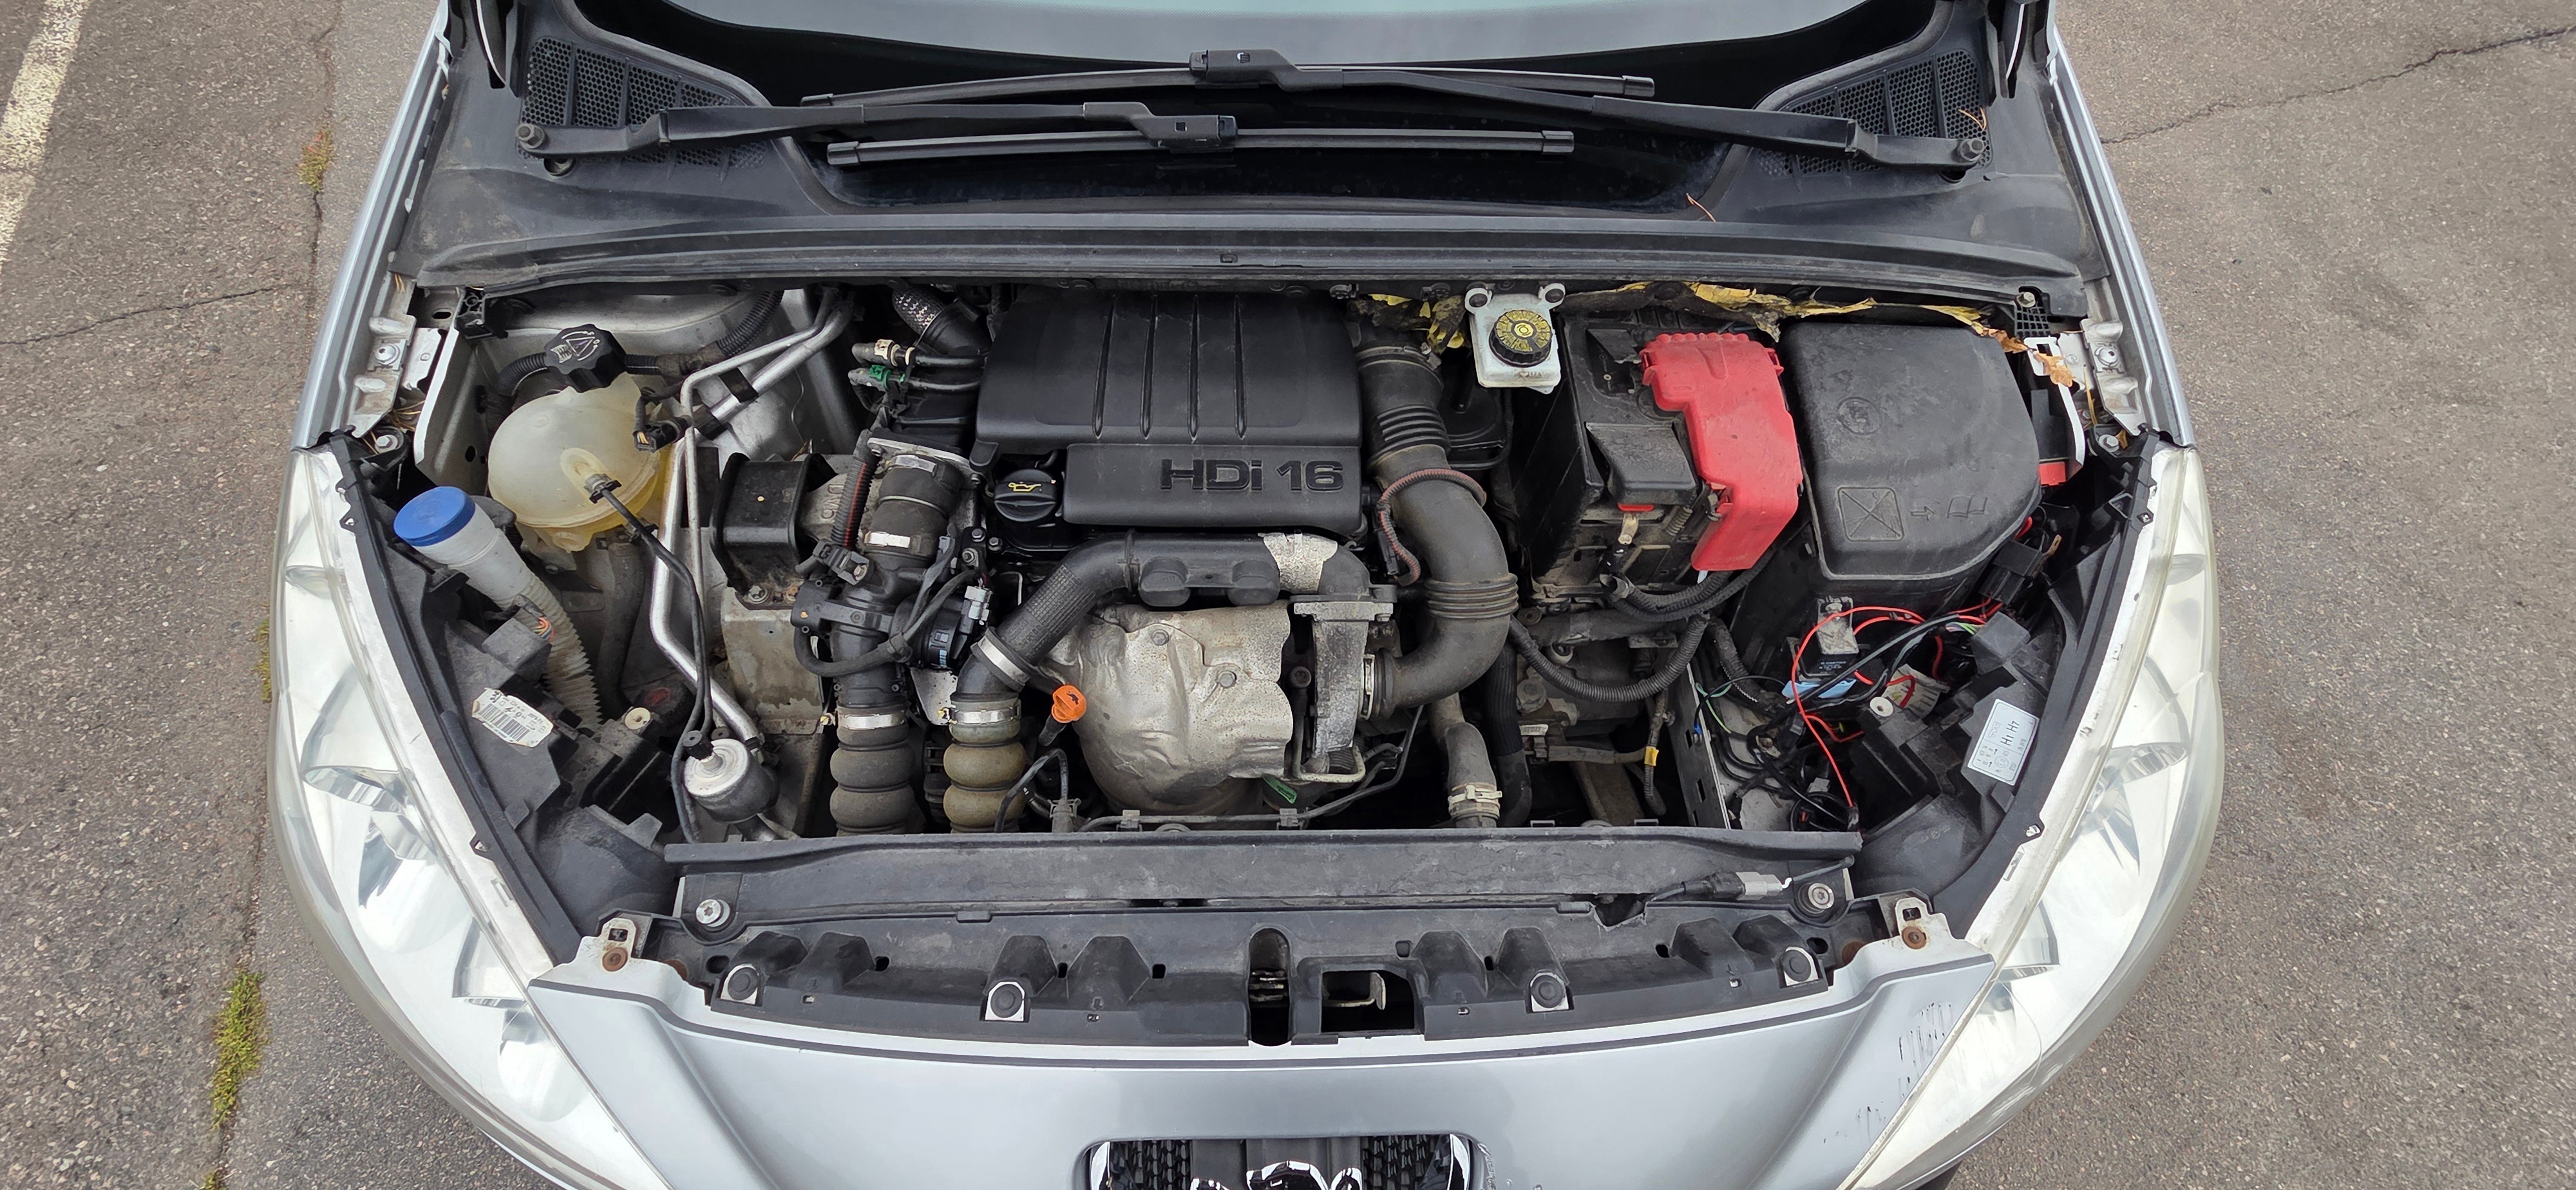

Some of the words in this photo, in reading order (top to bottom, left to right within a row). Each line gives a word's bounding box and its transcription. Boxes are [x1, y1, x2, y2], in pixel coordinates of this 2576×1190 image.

[1160, 459, 1262, 491] HDi
[1276, 460, 1343, 491] 16
[2005, 721, 2020, 733] H7
[2000, 735, 2014, 746] H1
